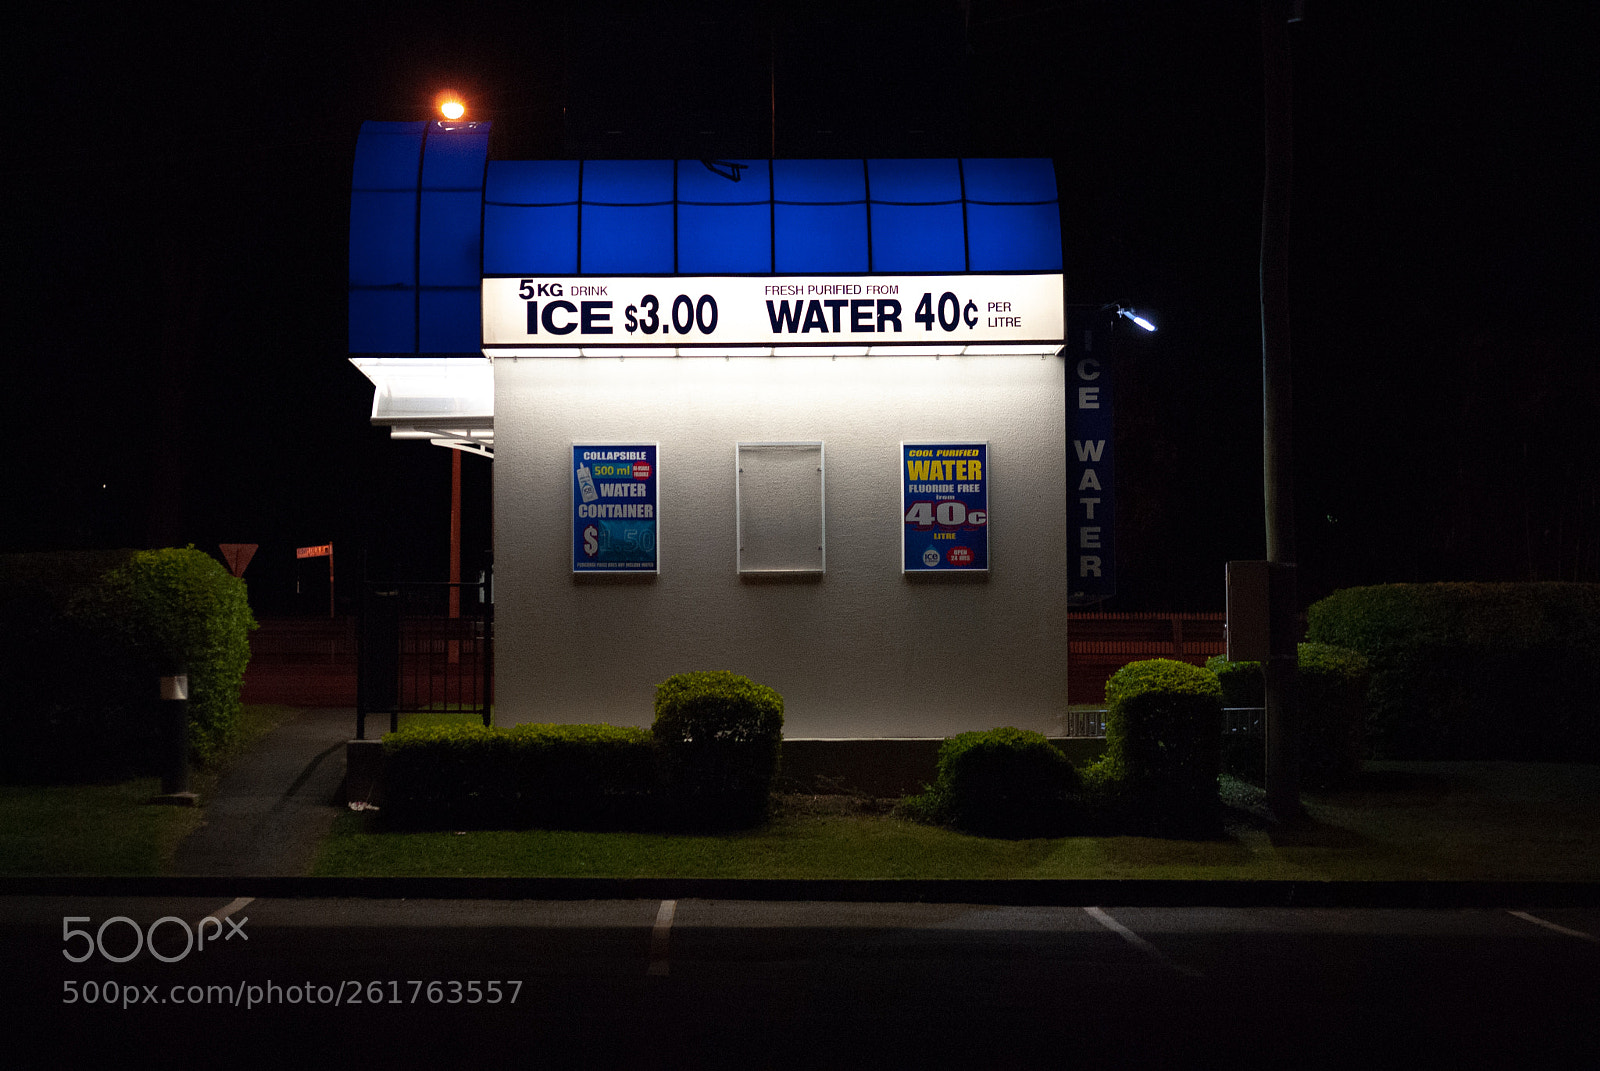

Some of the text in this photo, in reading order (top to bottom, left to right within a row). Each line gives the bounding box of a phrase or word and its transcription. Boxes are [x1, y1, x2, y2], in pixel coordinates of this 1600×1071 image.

[518, 279, 608, 300] 5KG DRINK
[765, 285, 899, 295] FRESH PURIFIED FROM
[766, 291, 978, 333] WATER 40¢
[988, 302, 1011, 312] PER
[527, 294, 718, 335] ICE $3.00
[988, 317, 1021, 327] LITRE
[583, 451, 647, 460] COLLAPSIBLE
[908, 449, 979, 457] COOL PURIFIED
[1074, 330, 1106, 578] ICE WATER
[594, 466, 630, 475] 500 ml
[907, 460, 982, 480] WATER
[600, 483, 646, 497] WATER
[908, 484, 980, 493] FLUORIDE FREE
[578, 504, 653, 518] CONTAINER
[905, 502, 987, 526] 40c
